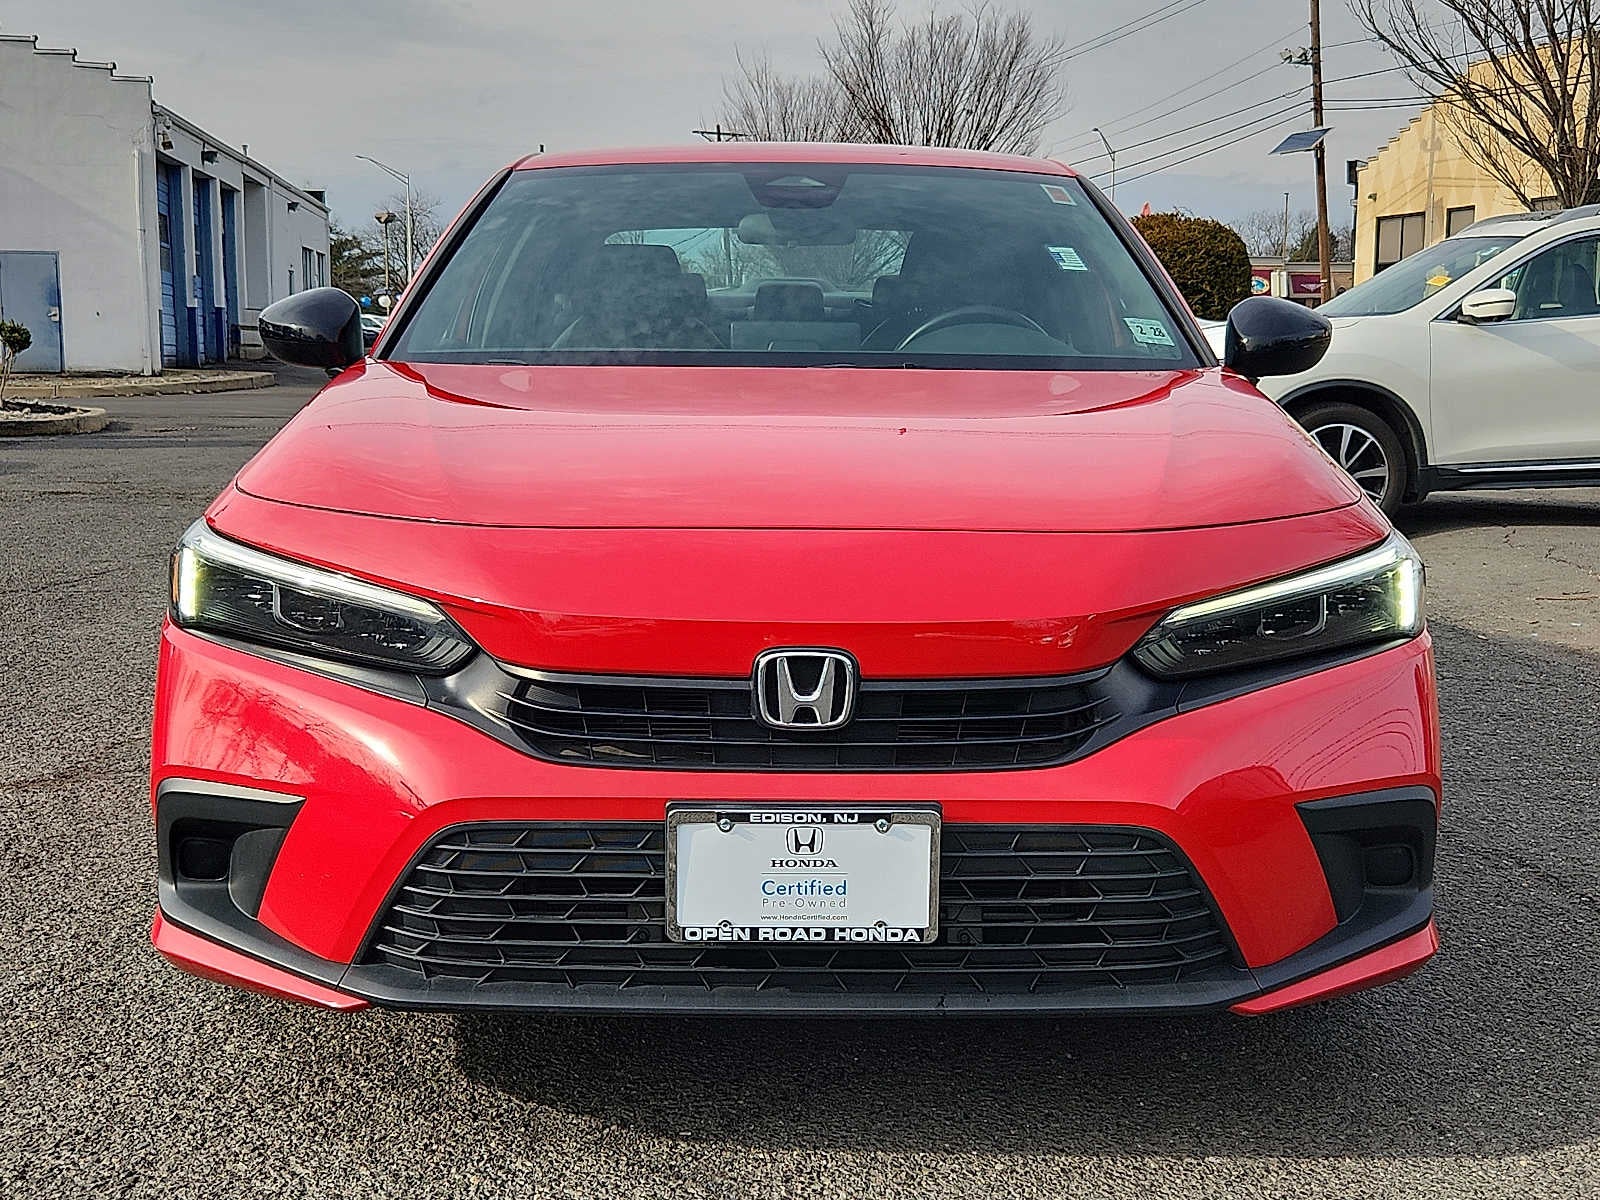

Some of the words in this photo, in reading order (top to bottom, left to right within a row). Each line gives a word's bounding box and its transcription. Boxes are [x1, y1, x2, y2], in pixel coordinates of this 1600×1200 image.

[1135, 324, 1147, 336] 2
[833, 813, 859, 823] NJ
[770, 859, 840, 868] HONDA
[761, 879, 847, 896] Certified
[762, 898, 847, 908] Pre-Owned
[684, 927, 751, 941] OPEN
[758, 927, 827, 941] ROAD
[834, 927, 921, 942] HONDA
